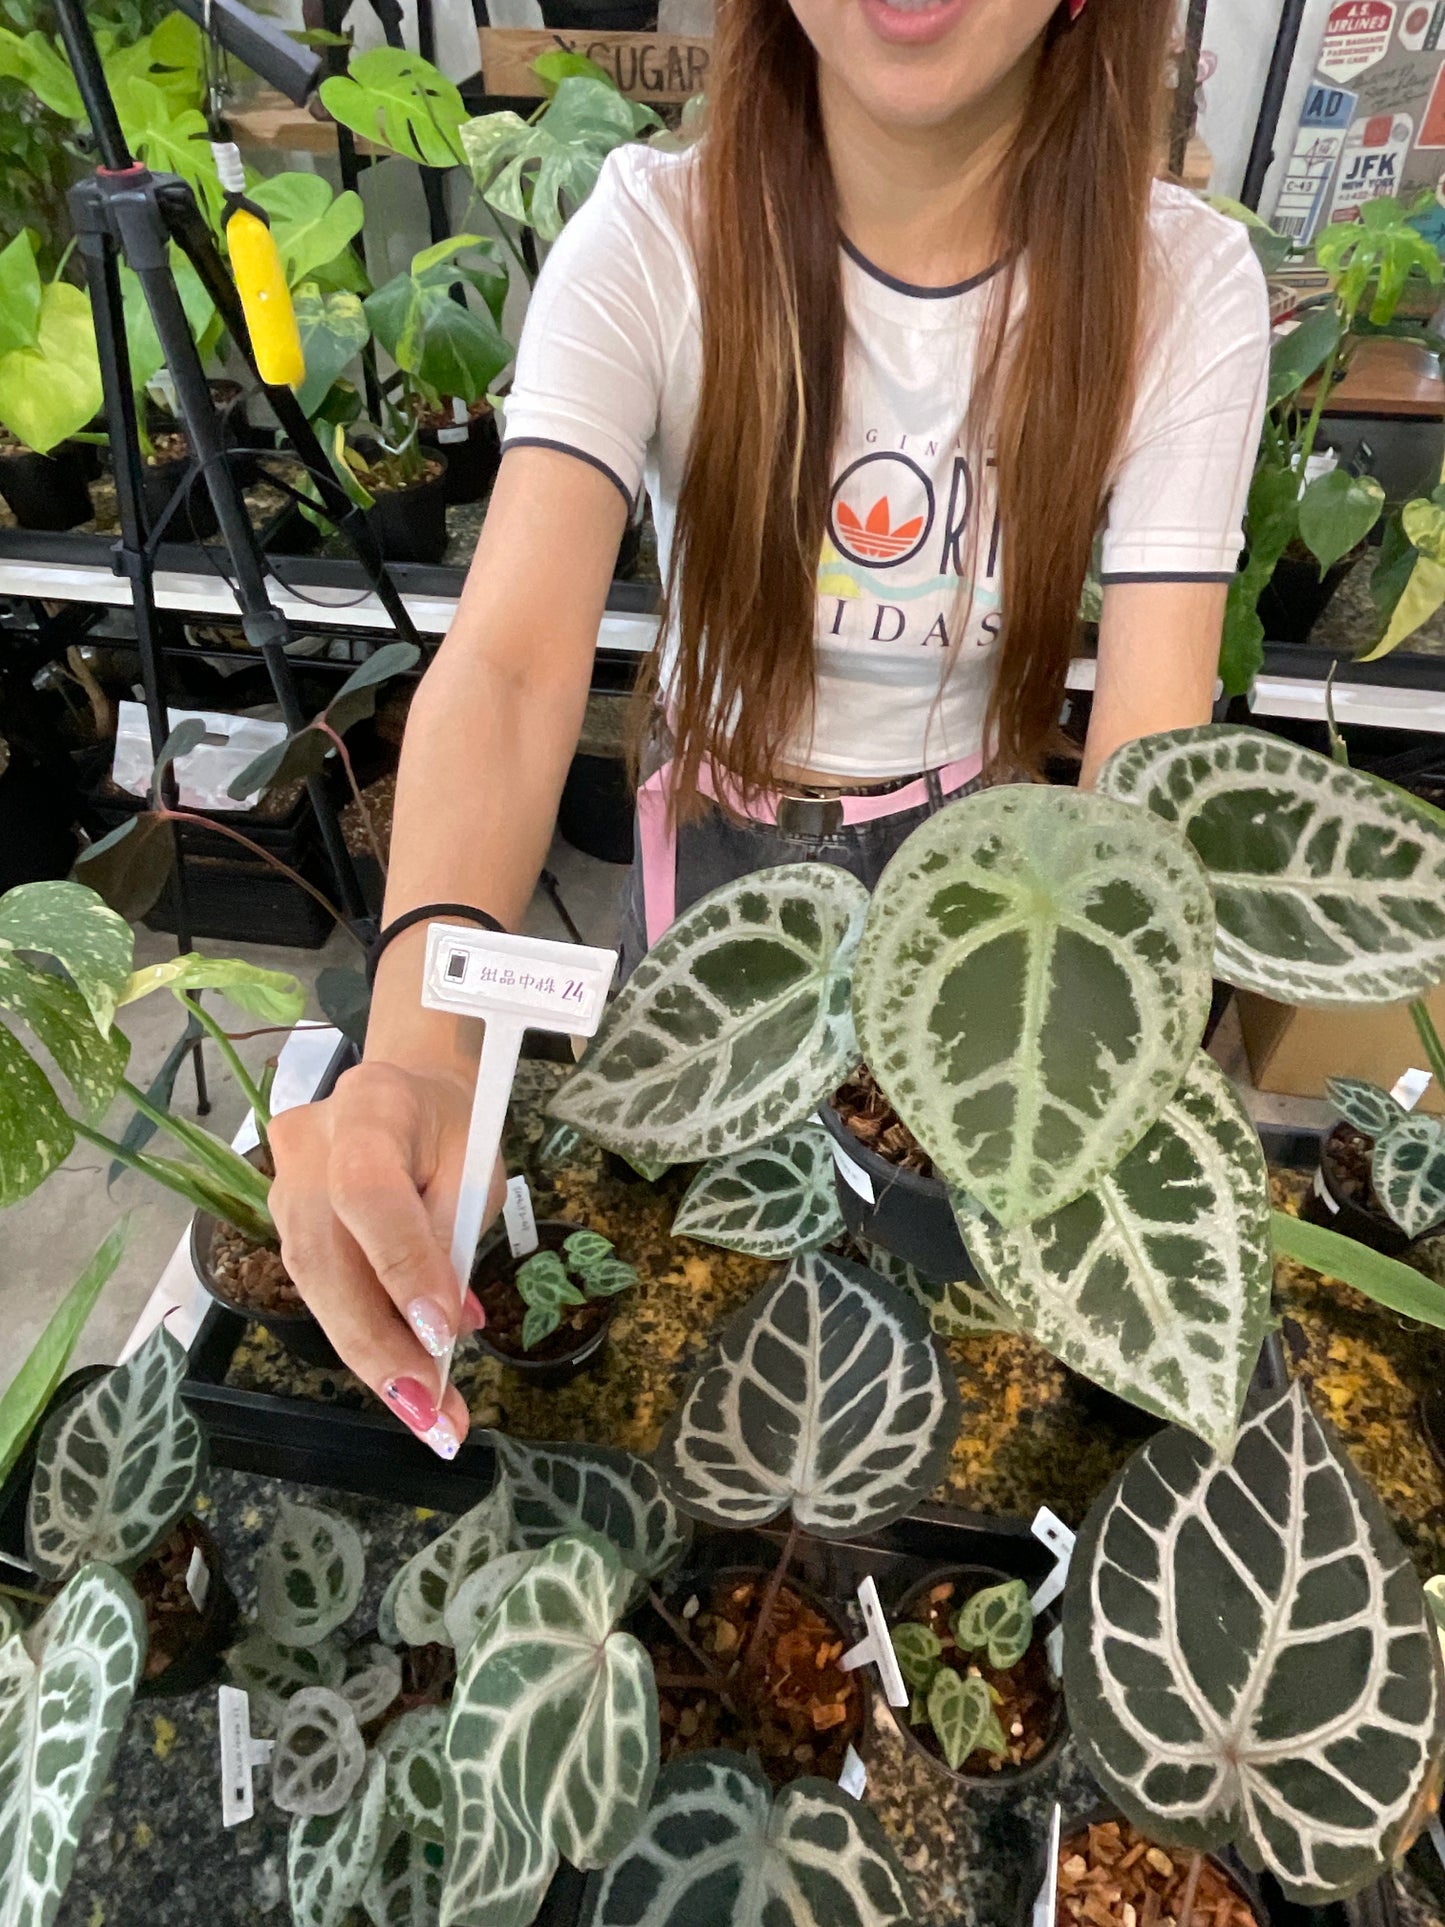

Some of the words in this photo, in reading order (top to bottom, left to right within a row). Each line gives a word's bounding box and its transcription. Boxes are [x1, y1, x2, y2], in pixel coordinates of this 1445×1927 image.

[1307, 89, 1344, 118] AD
[1346, 152, 1398, 180] JFK
[829, 599, 1002, 647] IDAS
[561, 979, 584, 1003] 24
